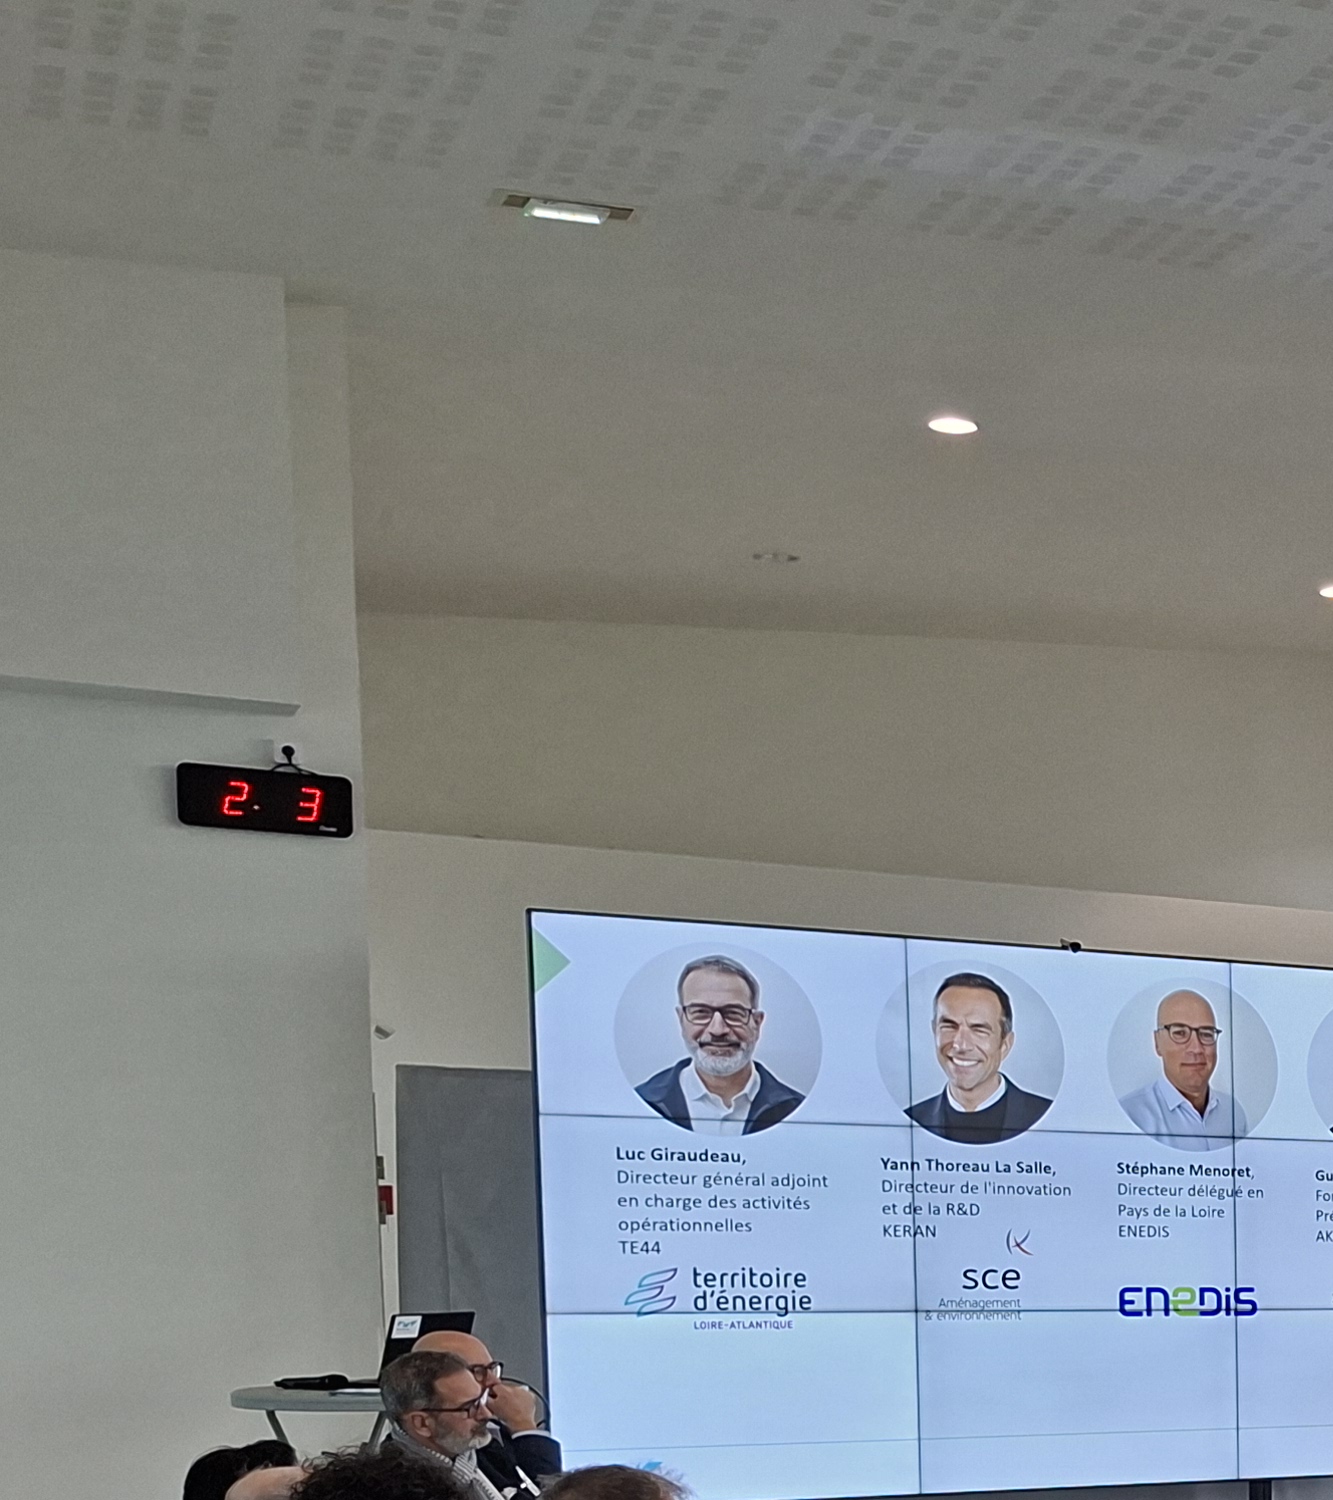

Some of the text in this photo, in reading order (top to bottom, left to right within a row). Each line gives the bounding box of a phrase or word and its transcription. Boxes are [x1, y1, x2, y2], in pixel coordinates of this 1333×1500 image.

[616, 1147, 746, 1165] Luc Giraudeau,
[880, 1158, 1056, 1177] Yann Thoreau La Salle,
[1117, 1162, 1254, 1179] Stéphane Menoret,
[617, 1170, 829, 1190] Directeur général adjoint
[881, 1180, 1071, 1196] Directeur de l'innovation
[1117, 1183, 1264, 1200] Directeur délégué en
[617, 1194, 810, 1211] en charge des activités
[882, 1202, 980, 1216] et de la R&D
[1118, 1204, 1225, 1219] Pays de la Loire
[618, 1217, 752, 1234] opérationnelles
[883, 1224, 936, 1238] KERAN
[1118, 1225, 1170, 1238] ENEDIS
[618, 1241, 661, 1254] TE44
[693, 1267, 807, 1288] territoire
[962, 1268, 1021, 1290] sce
[693, 1290, 812, 1317] d'énergie
[938, 1297, 1021, 1311] Aménagement
[924, 1311, 933, 1321] &
[694, 1320, 794, 1330] LOIRE-ATLANTIQUE
